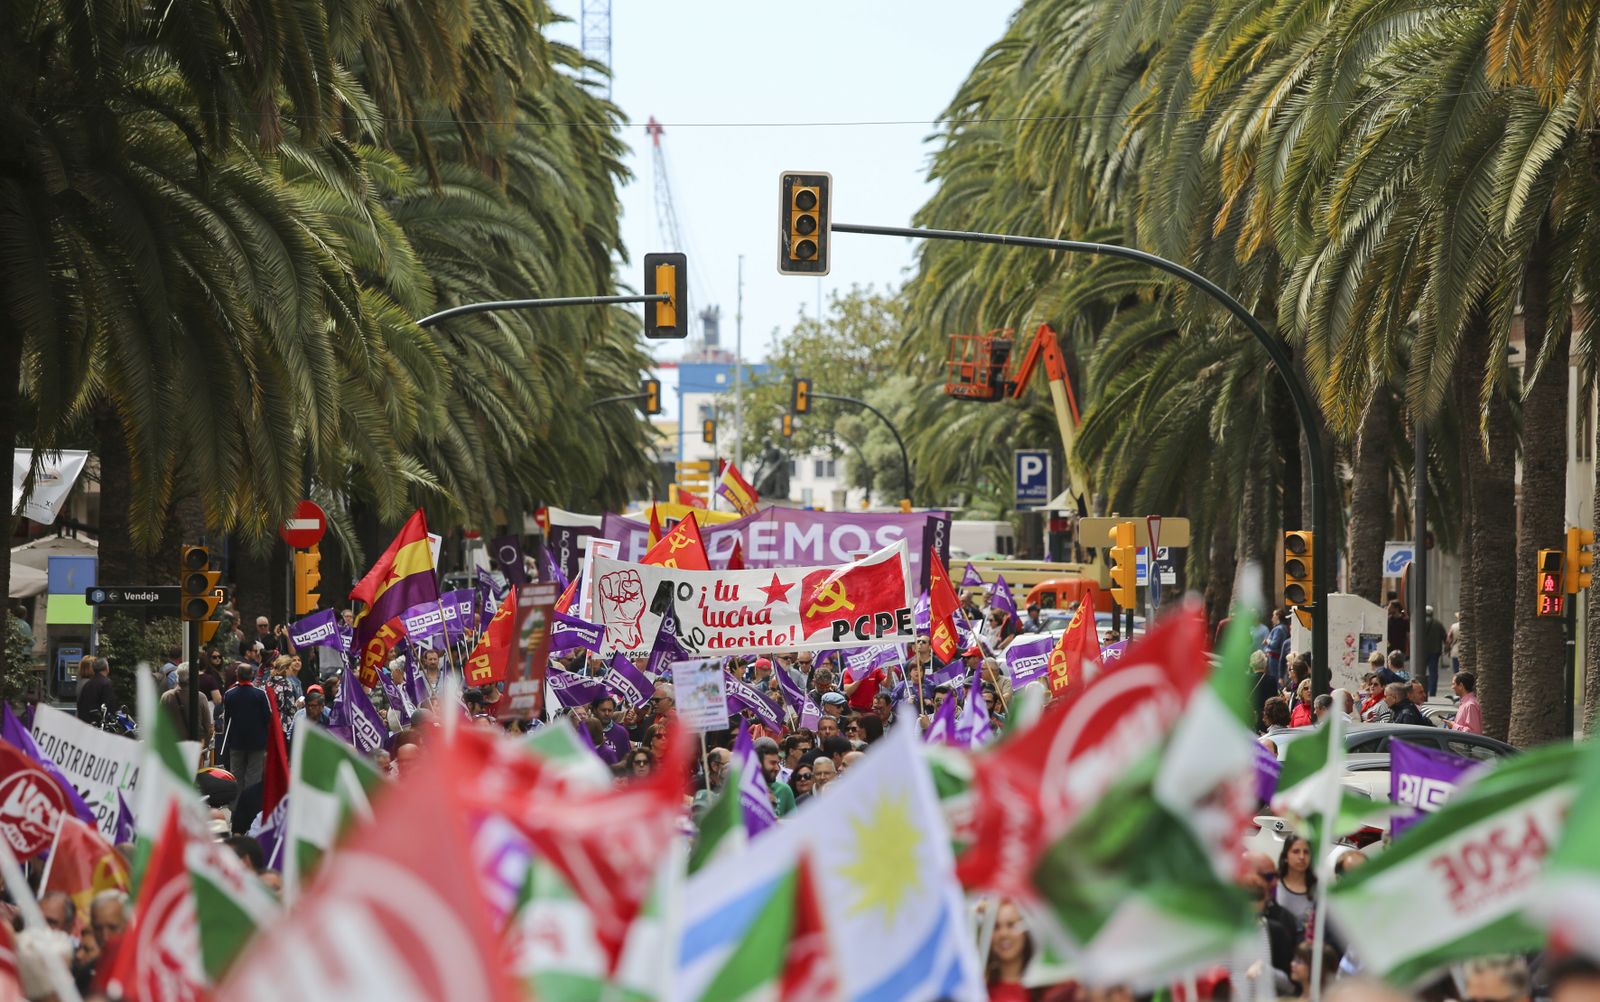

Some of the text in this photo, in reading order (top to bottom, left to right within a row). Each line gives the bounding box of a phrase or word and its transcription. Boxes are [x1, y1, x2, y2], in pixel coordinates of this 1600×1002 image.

[1021, 456, 1043, 484] P
[630, 521, 920, 562] PDEMOS.
[124, 592, 159, 602] Vendeja
[1543, 596, 1559, 614] 31
[702, 605, 773, 628] lucha
[832, 608, 914, 642] PCPE
[707, 625, 796, 649] decide!
[119, 761, 140, 791] LA
